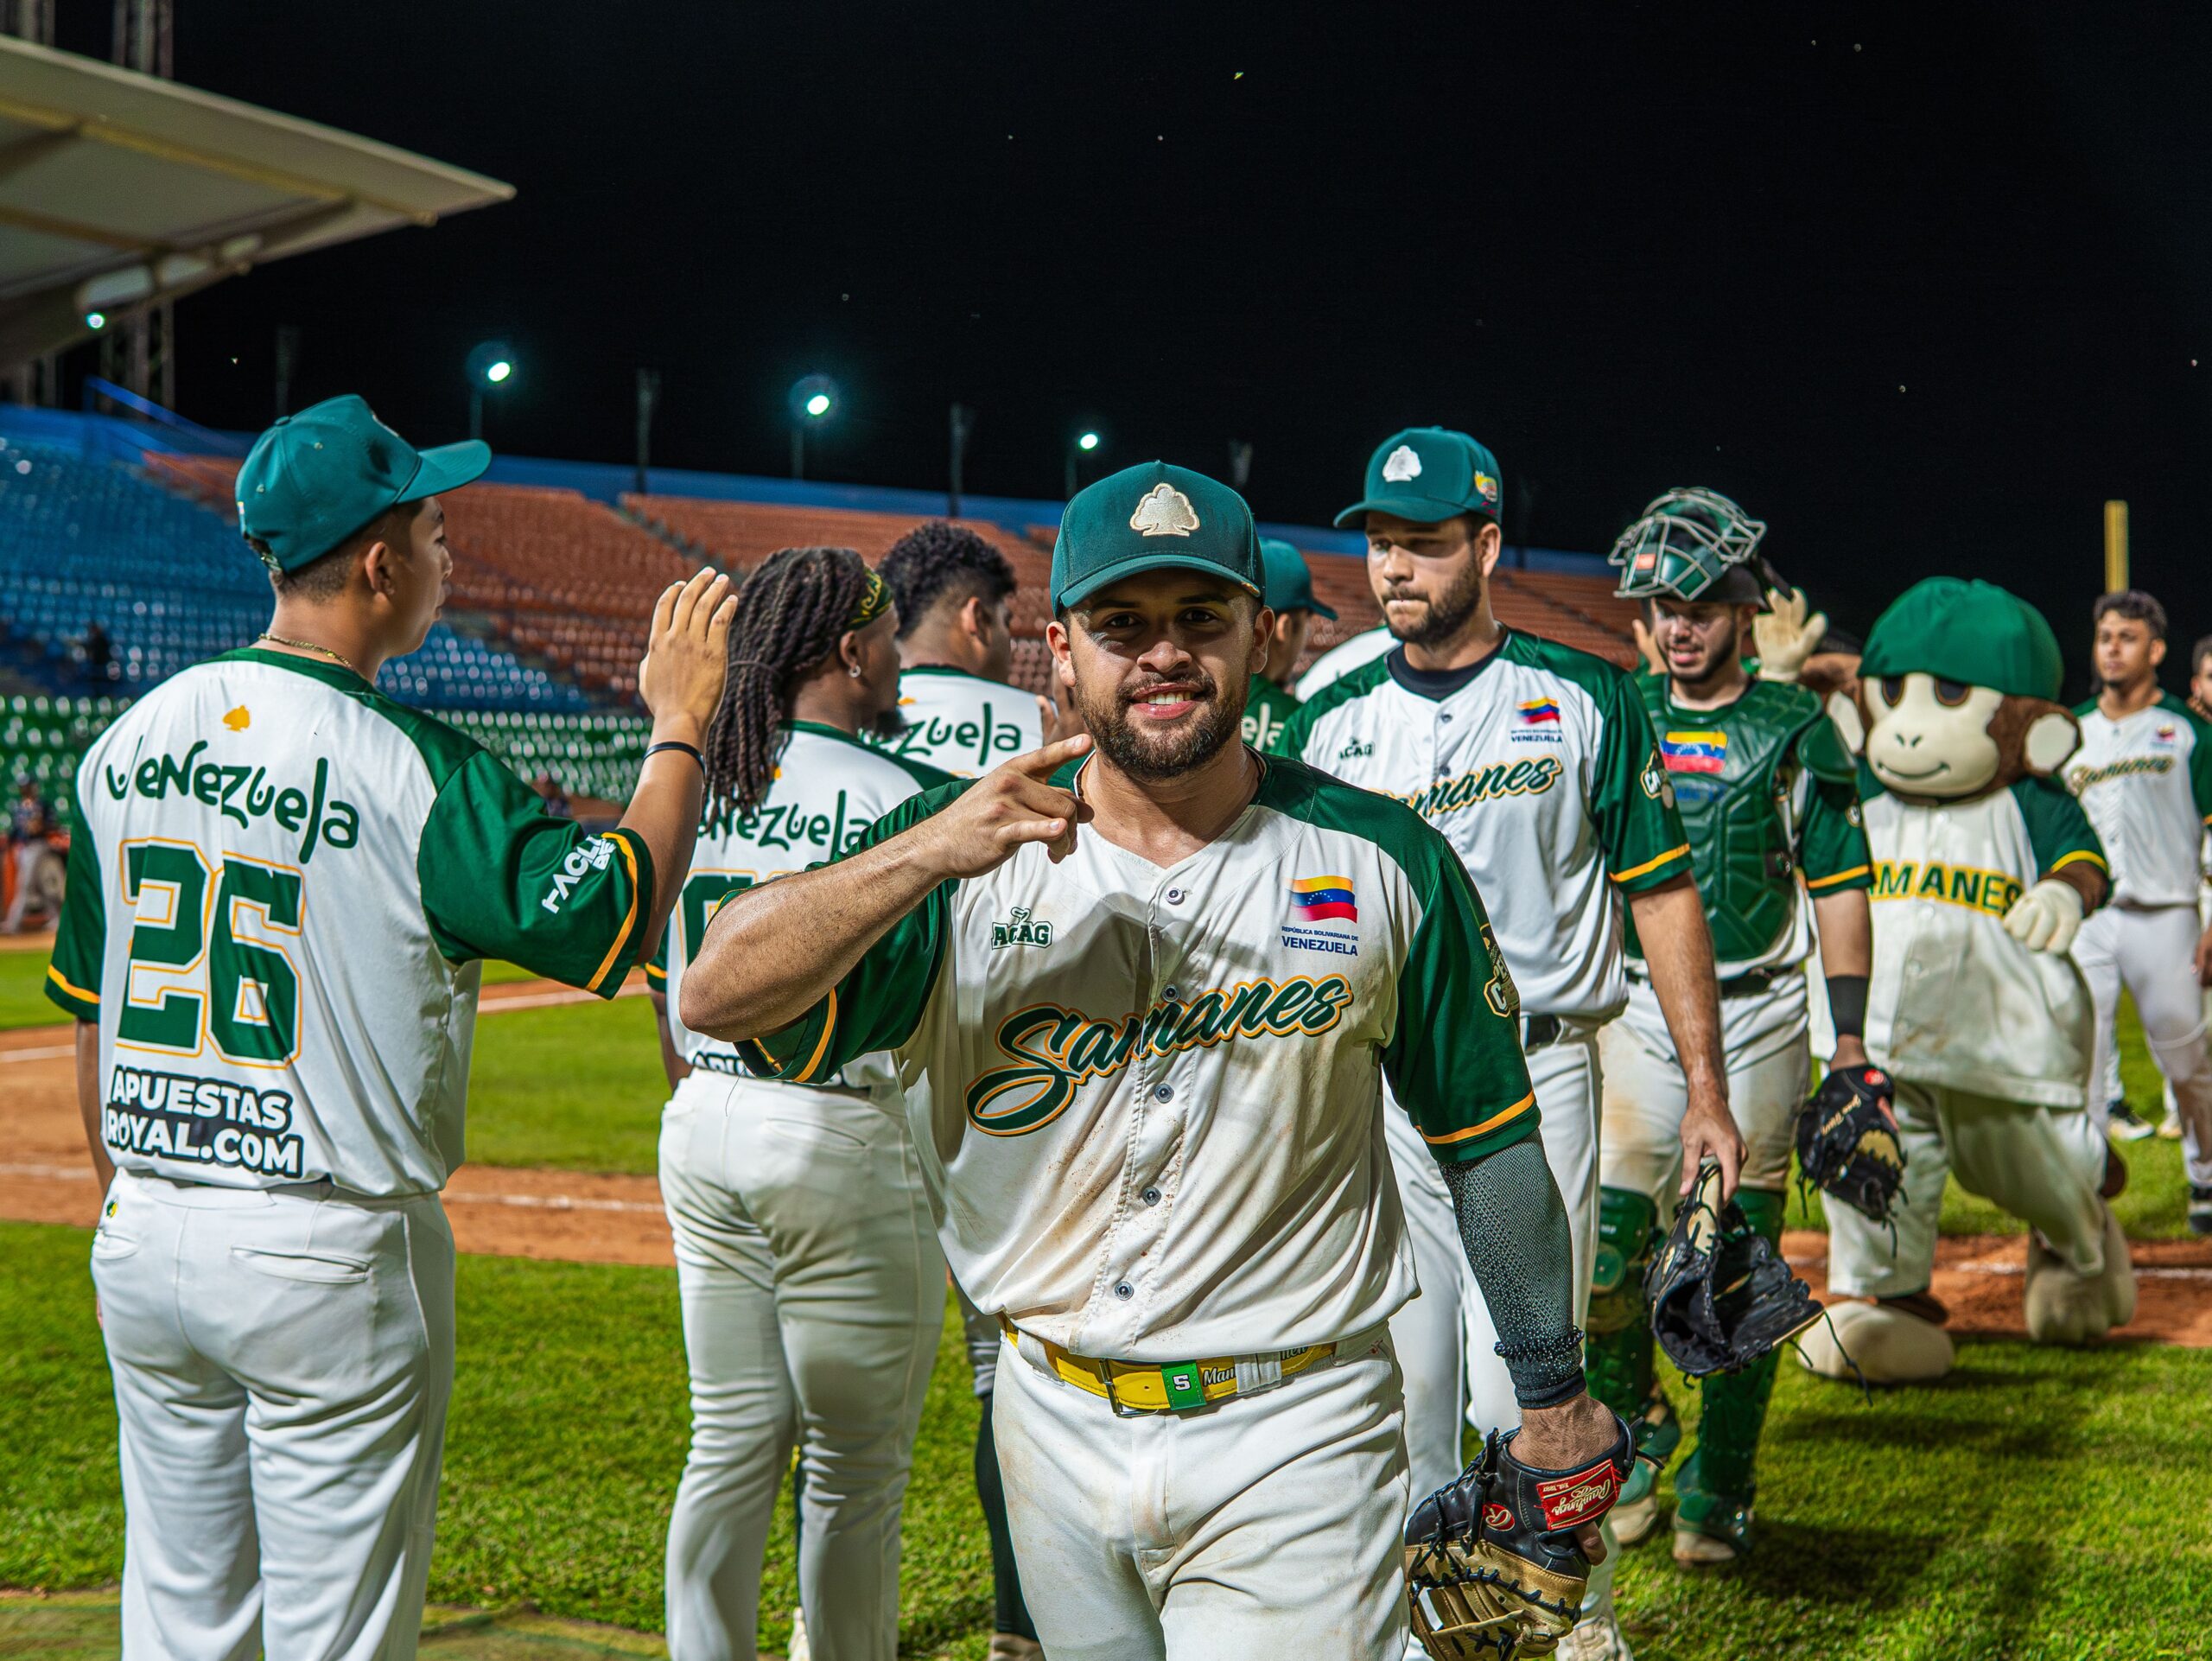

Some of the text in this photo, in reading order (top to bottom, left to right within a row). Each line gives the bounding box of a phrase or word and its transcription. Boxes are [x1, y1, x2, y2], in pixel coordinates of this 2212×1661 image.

[116, 836, 304, 1069] 26
[1281, 926, 1313, 935] REPÚBLICA
[1313, 930, 1351, 940] BOLIVARIANA
[1281, 936, 1358, 957] VENEZUELA
[965, 973, 1354, 1136] Samanes
[111, 1066, 291, 1134] APUESTAS
[106, 1105, 302, 1176] ROYAL.COM
[1173, 1374, 1190, 1391] 5
[1551, 1479, 1611, 1516] Rawlings
